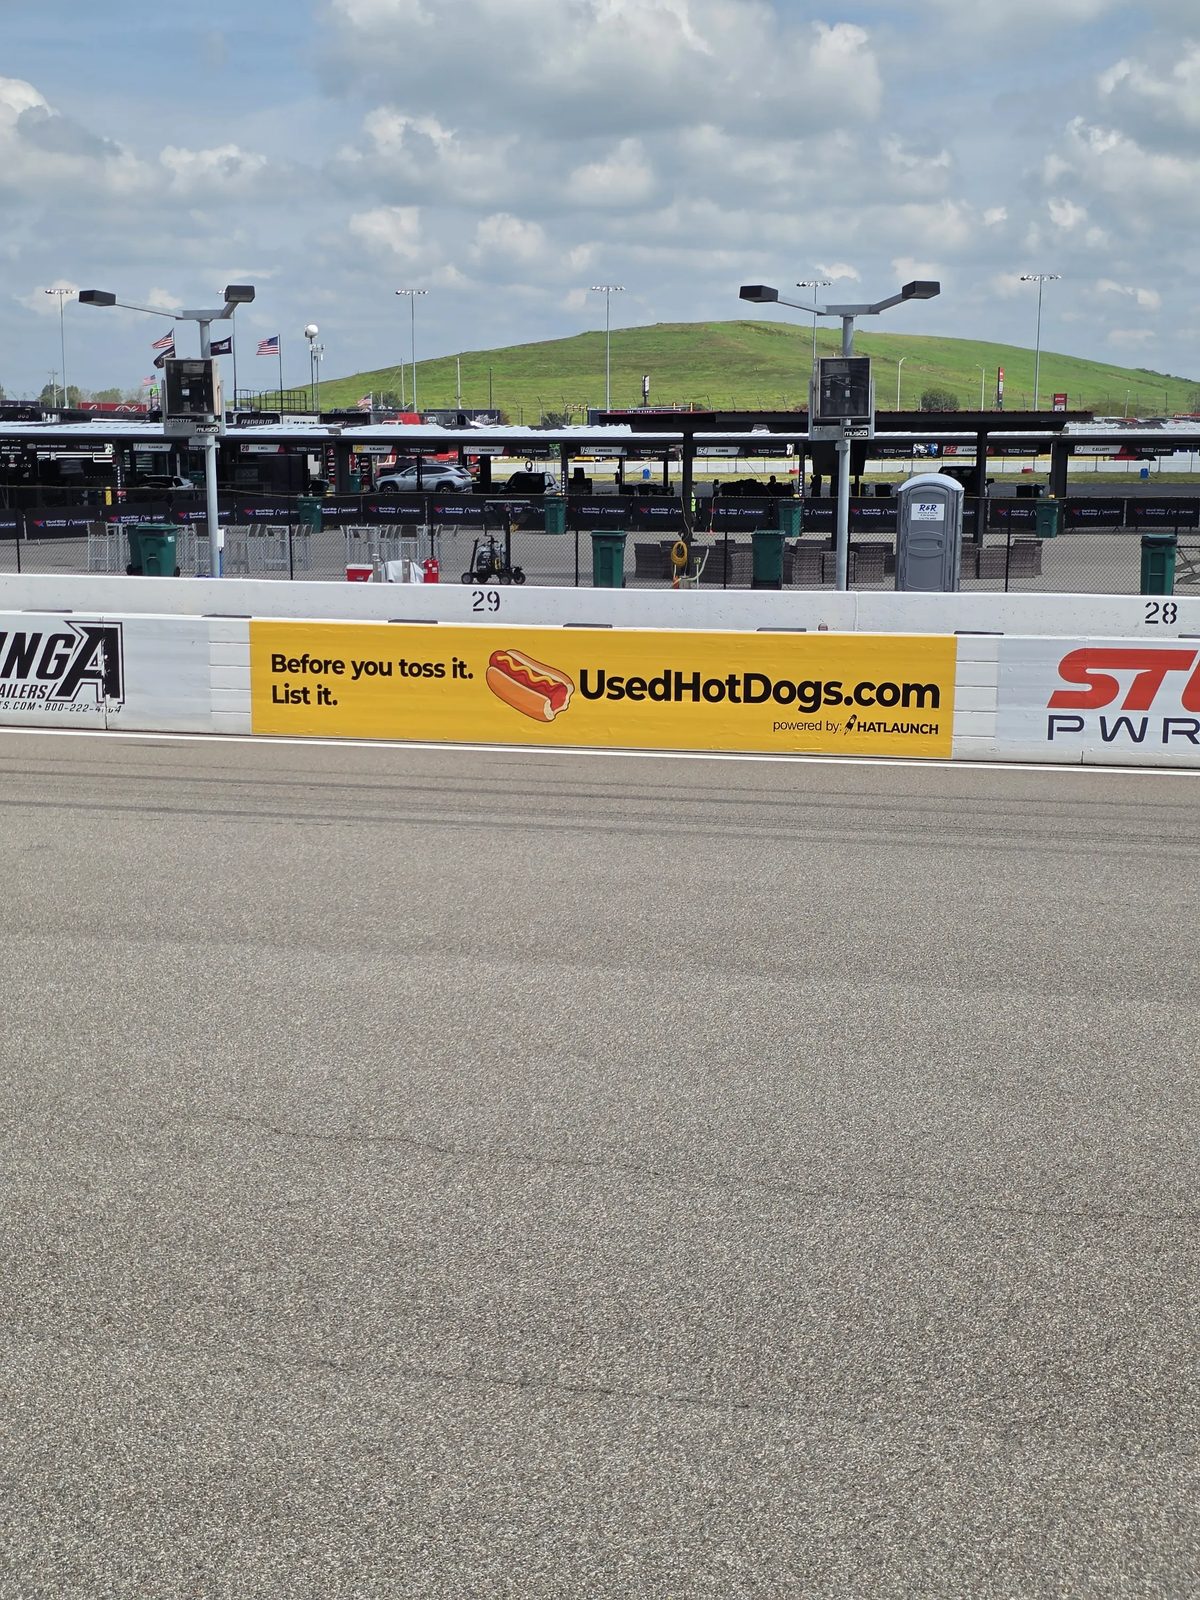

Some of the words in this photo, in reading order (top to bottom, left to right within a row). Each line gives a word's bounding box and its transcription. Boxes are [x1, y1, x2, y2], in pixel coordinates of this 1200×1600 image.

[944, 446, 958, 454] 22
[472, 590, 501, 612] 29
[1144, 602, 1178, 624] 28
[271, 653, 345, 675] Before
[351, 661, 392, 680] you
[399, 659, 446, 679] toss
[452, 657, 474, 679] it.
[272, 683, 311, 705] List
[317, 684, 338, 706] it.
[579, 669, 940, 713] UsedHotDogs.com
[772, 719, 814, 733] powered
[825, 719, 842, 733] by:
[857, 721, 939, 735] HATLAUNCH
